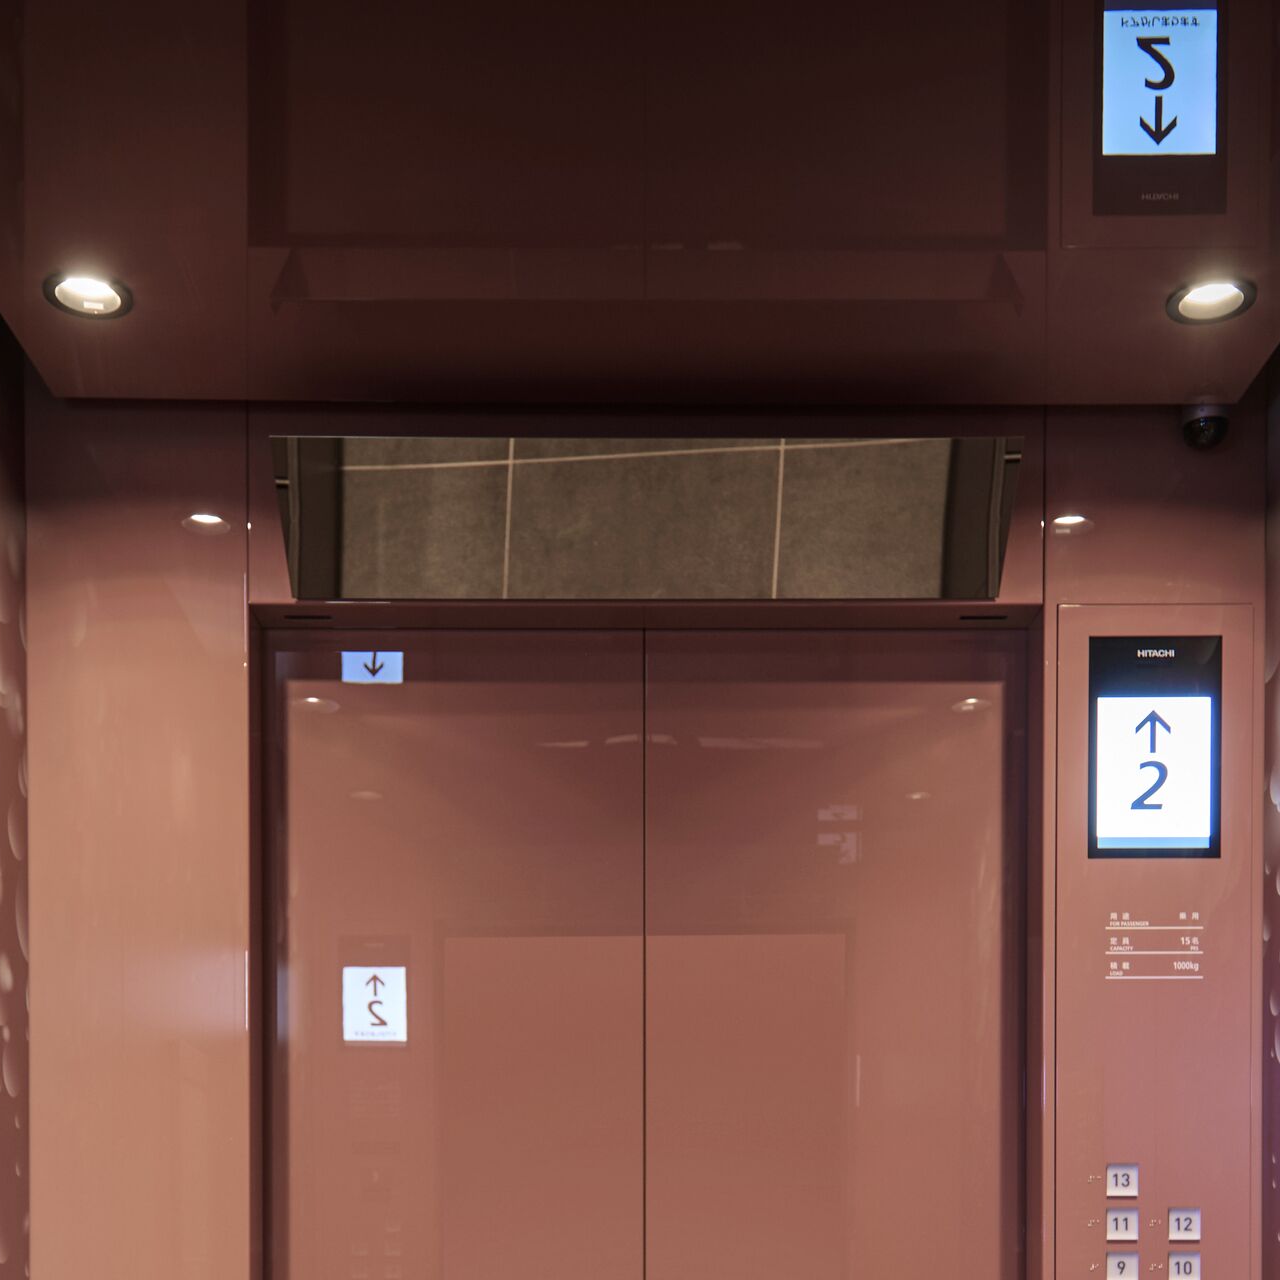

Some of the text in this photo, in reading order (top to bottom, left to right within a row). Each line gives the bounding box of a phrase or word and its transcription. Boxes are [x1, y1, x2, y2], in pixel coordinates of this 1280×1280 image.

[1137, 649, 1175, 658] HITACHI
[1130, 760, 1168, 810] 2
[1173, 961, 1199, 972] 1000kg
[1112, 1173, 1130, 1188] 13
[1112, 1217, 1129, 1232] 11
[1174, 1217, 1192, 1232] 12
[1117, 1261, 1126, 1275] 9
[1174, 1261, 1192, 1275] 10
